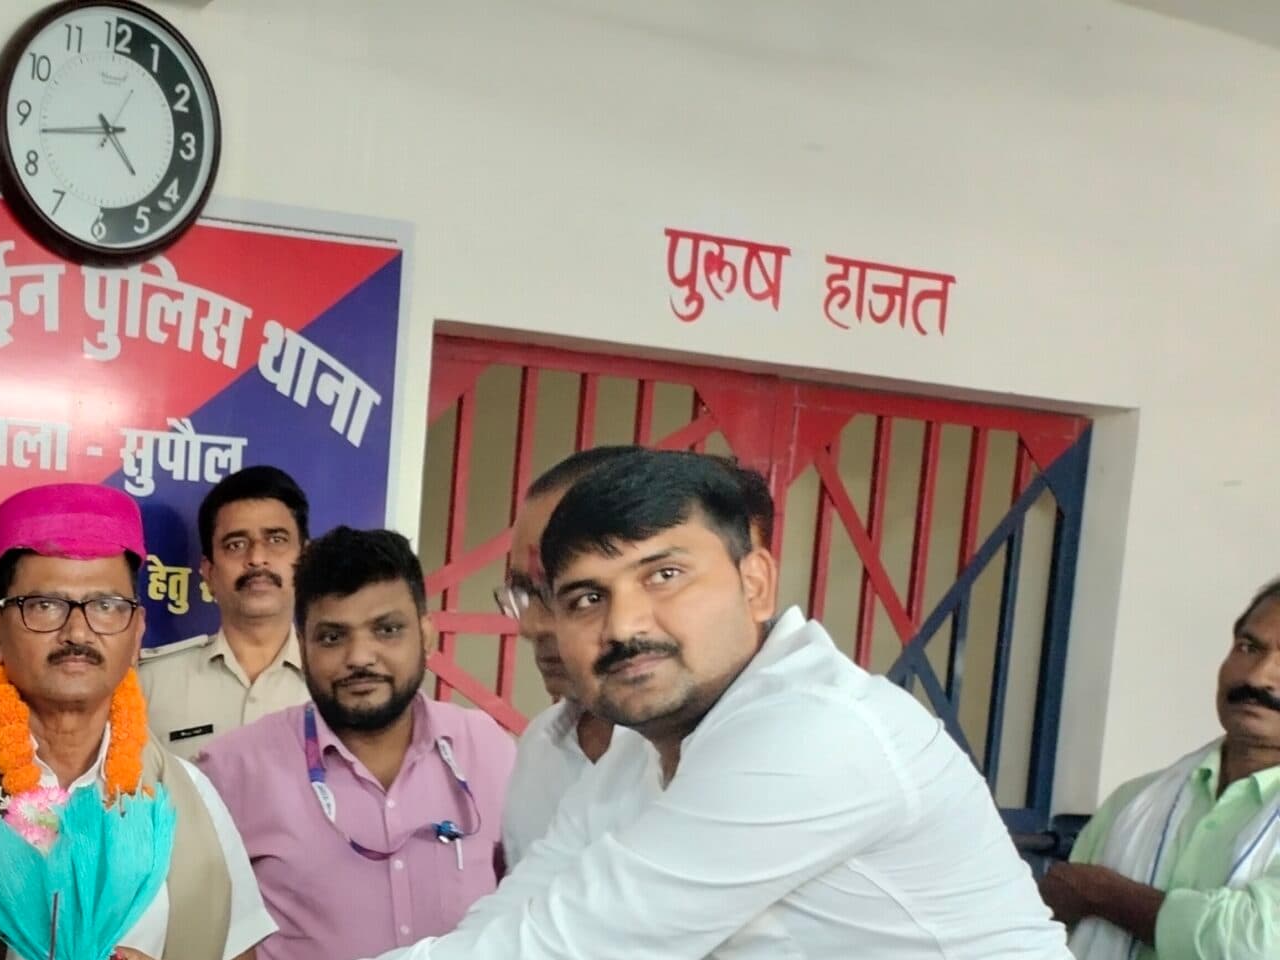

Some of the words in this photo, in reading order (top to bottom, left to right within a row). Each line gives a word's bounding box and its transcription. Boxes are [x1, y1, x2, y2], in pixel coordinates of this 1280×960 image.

[65, 23, 83, 53] 11
[105, 20, 133, 54] 12
[29, 52, 52, 82] 10
[151, 44, 161, 73] 1
[16, 99, 32, 126] 9
[173, 83, 191, 113] 2
[179, 132, 196, 161] 3
[24, 150, 39, 177] 8
[52, 188, 67, 216] 7
[162, 177, 181, 206] 4
[90, 211, 107, 242] 6
[133, 206, 151, 234] 5
[823, 254, 957, 336] हाजत
[80, 254, 253, 370] पुलिस
[258, 319, 383, 449] थाना
[120, 416, 249, 498] सुपौल
[146, 554, 193, 615] हेतु
